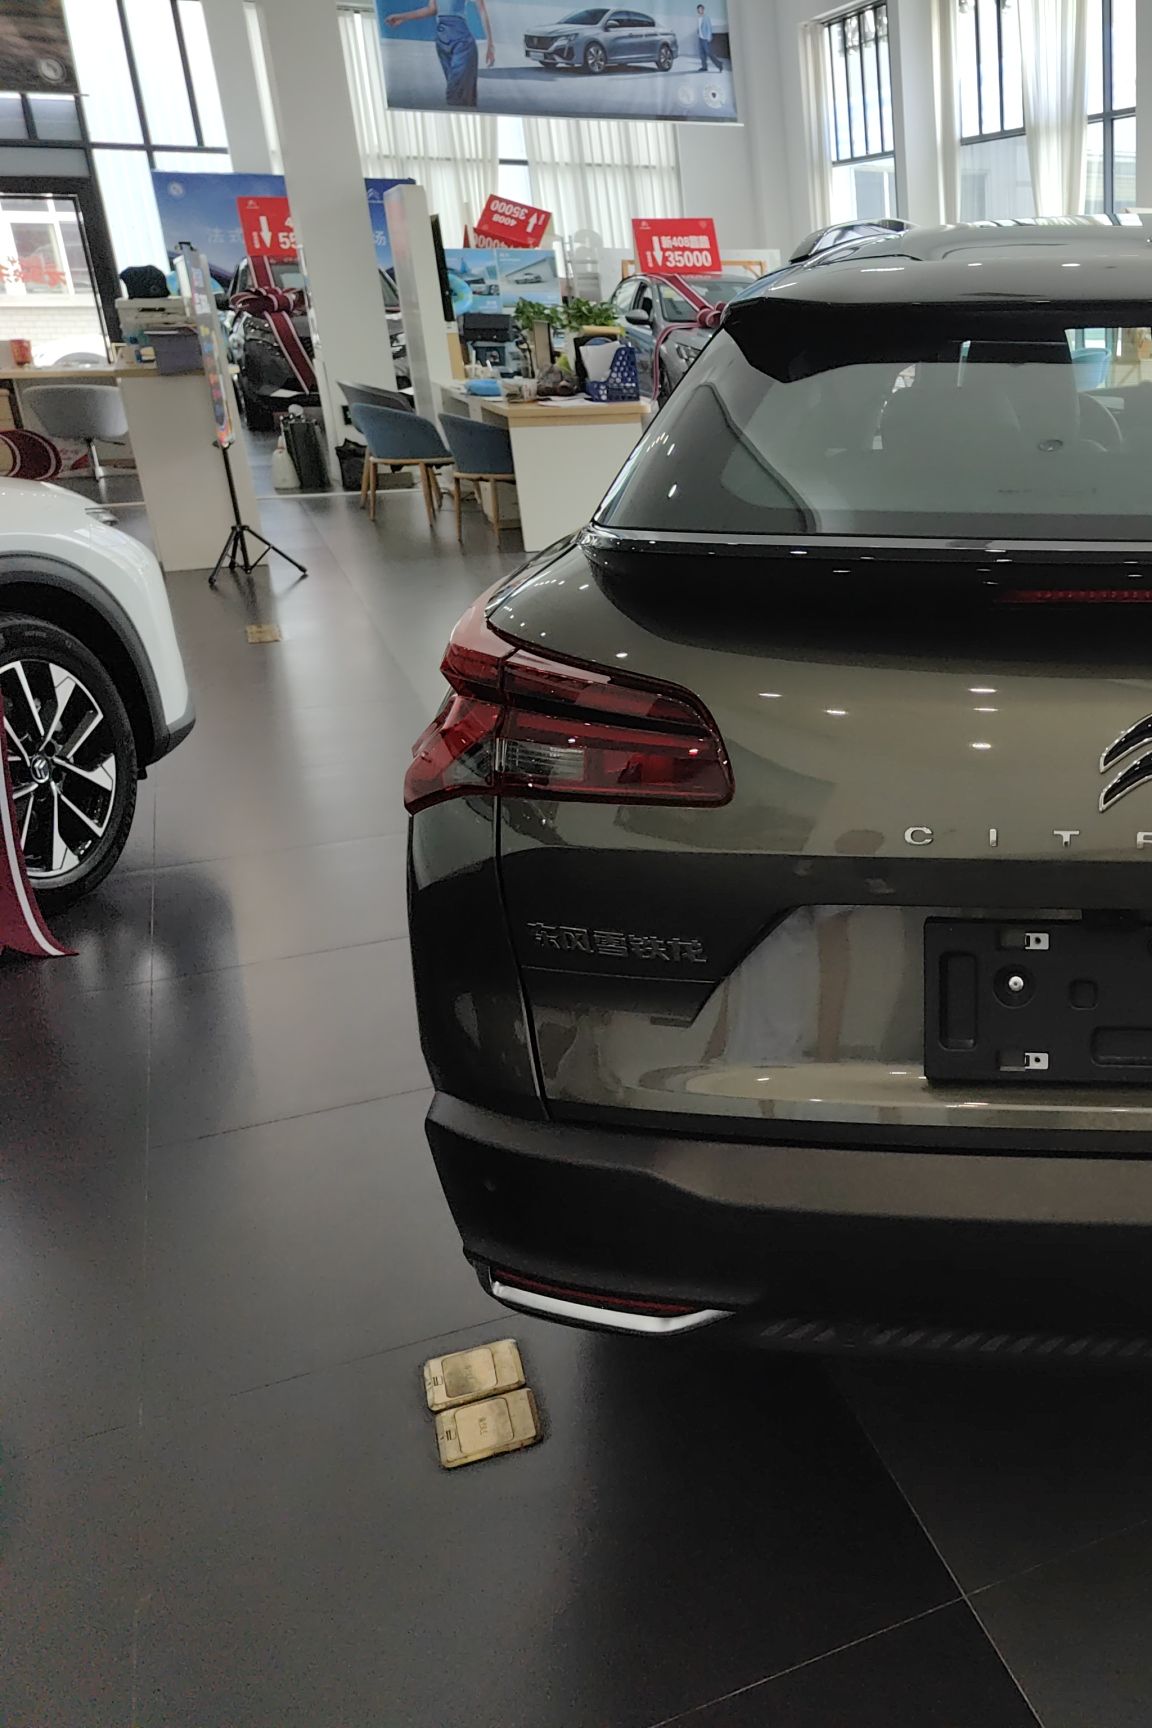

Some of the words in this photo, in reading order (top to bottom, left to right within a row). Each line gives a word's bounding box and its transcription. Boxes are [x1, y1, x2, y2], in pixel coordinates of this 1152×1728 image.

[490, 200, 529, 220] 35000
[665, 251, 712, 267] 35000
[527, 922, 707, 963] 东风雪铁龙
